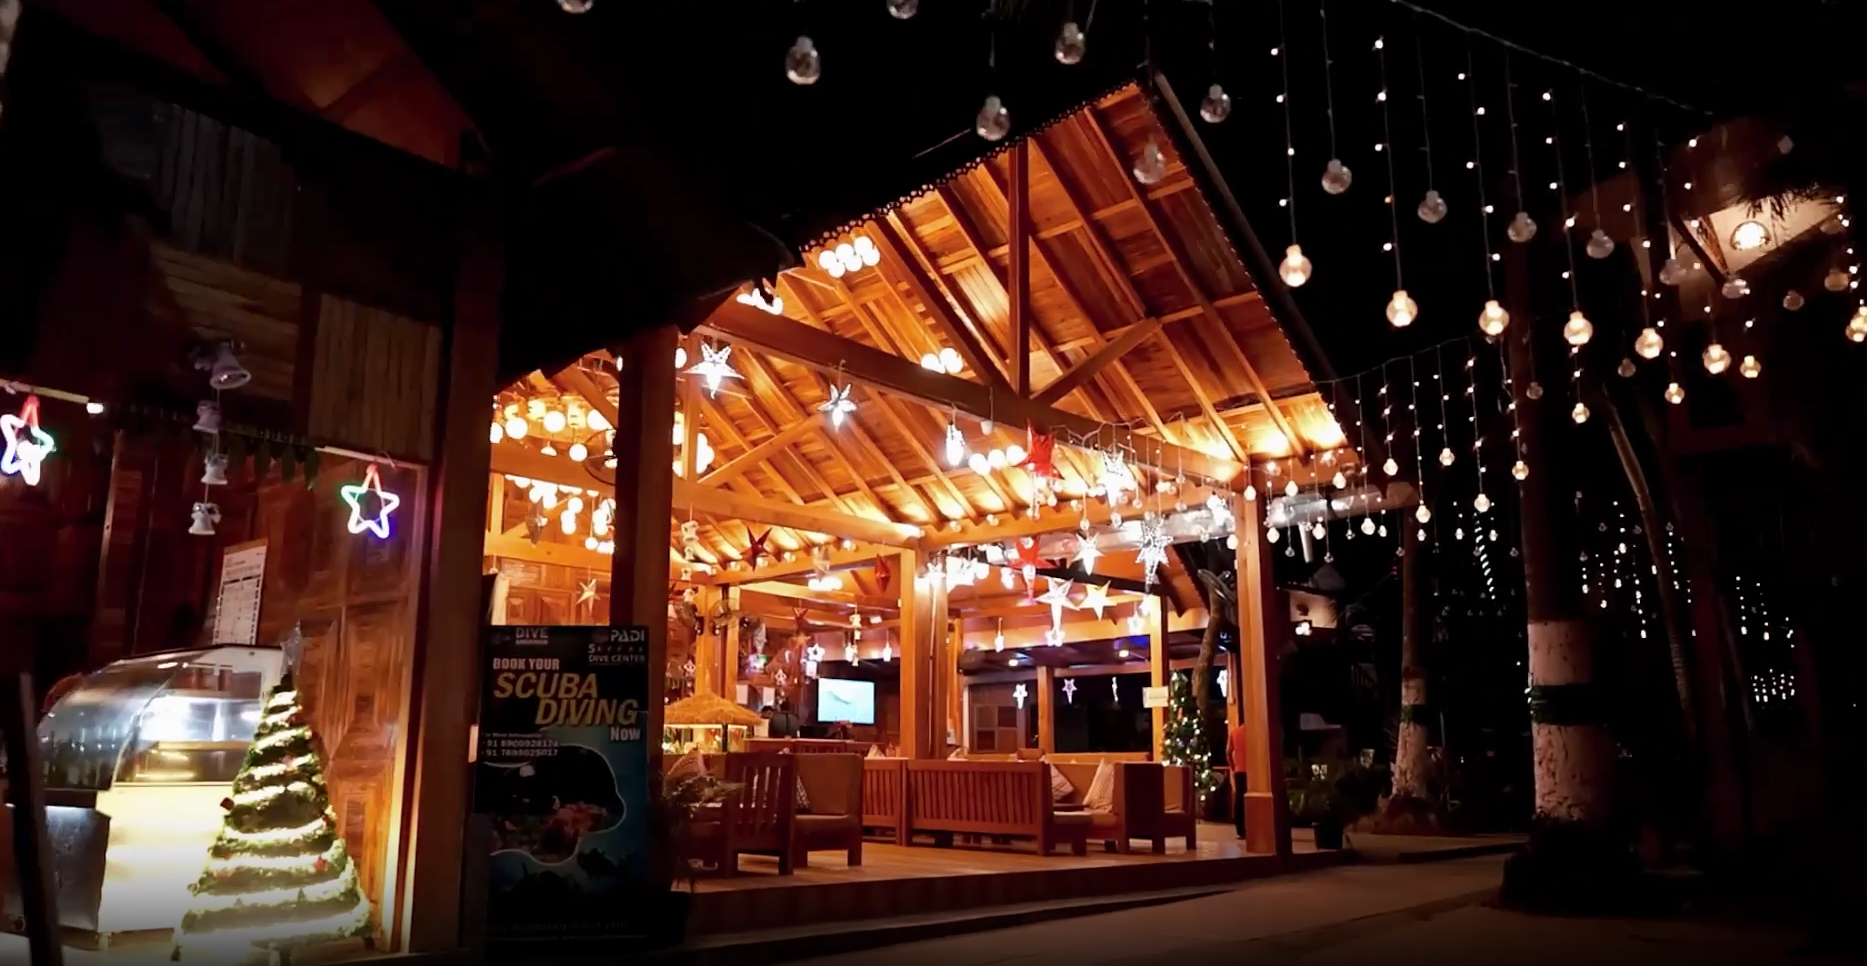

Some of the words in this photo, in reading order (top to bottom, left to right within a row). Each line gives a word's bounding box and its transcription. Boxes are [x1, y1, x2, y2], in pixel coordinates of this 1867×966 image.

[516, 627, 549, 639] DIVE
[610, 629, 645, 642] PADI
[493, 657, 527, 671] BOOK
[528, 657, 560, 671] YOUR
[588, 653, 609, 663] DIVE
[611, 653, 646, 663] CENTER
[493, 672, 599, 699] SCUBA
[535, 698, 640, 727] DIVING
